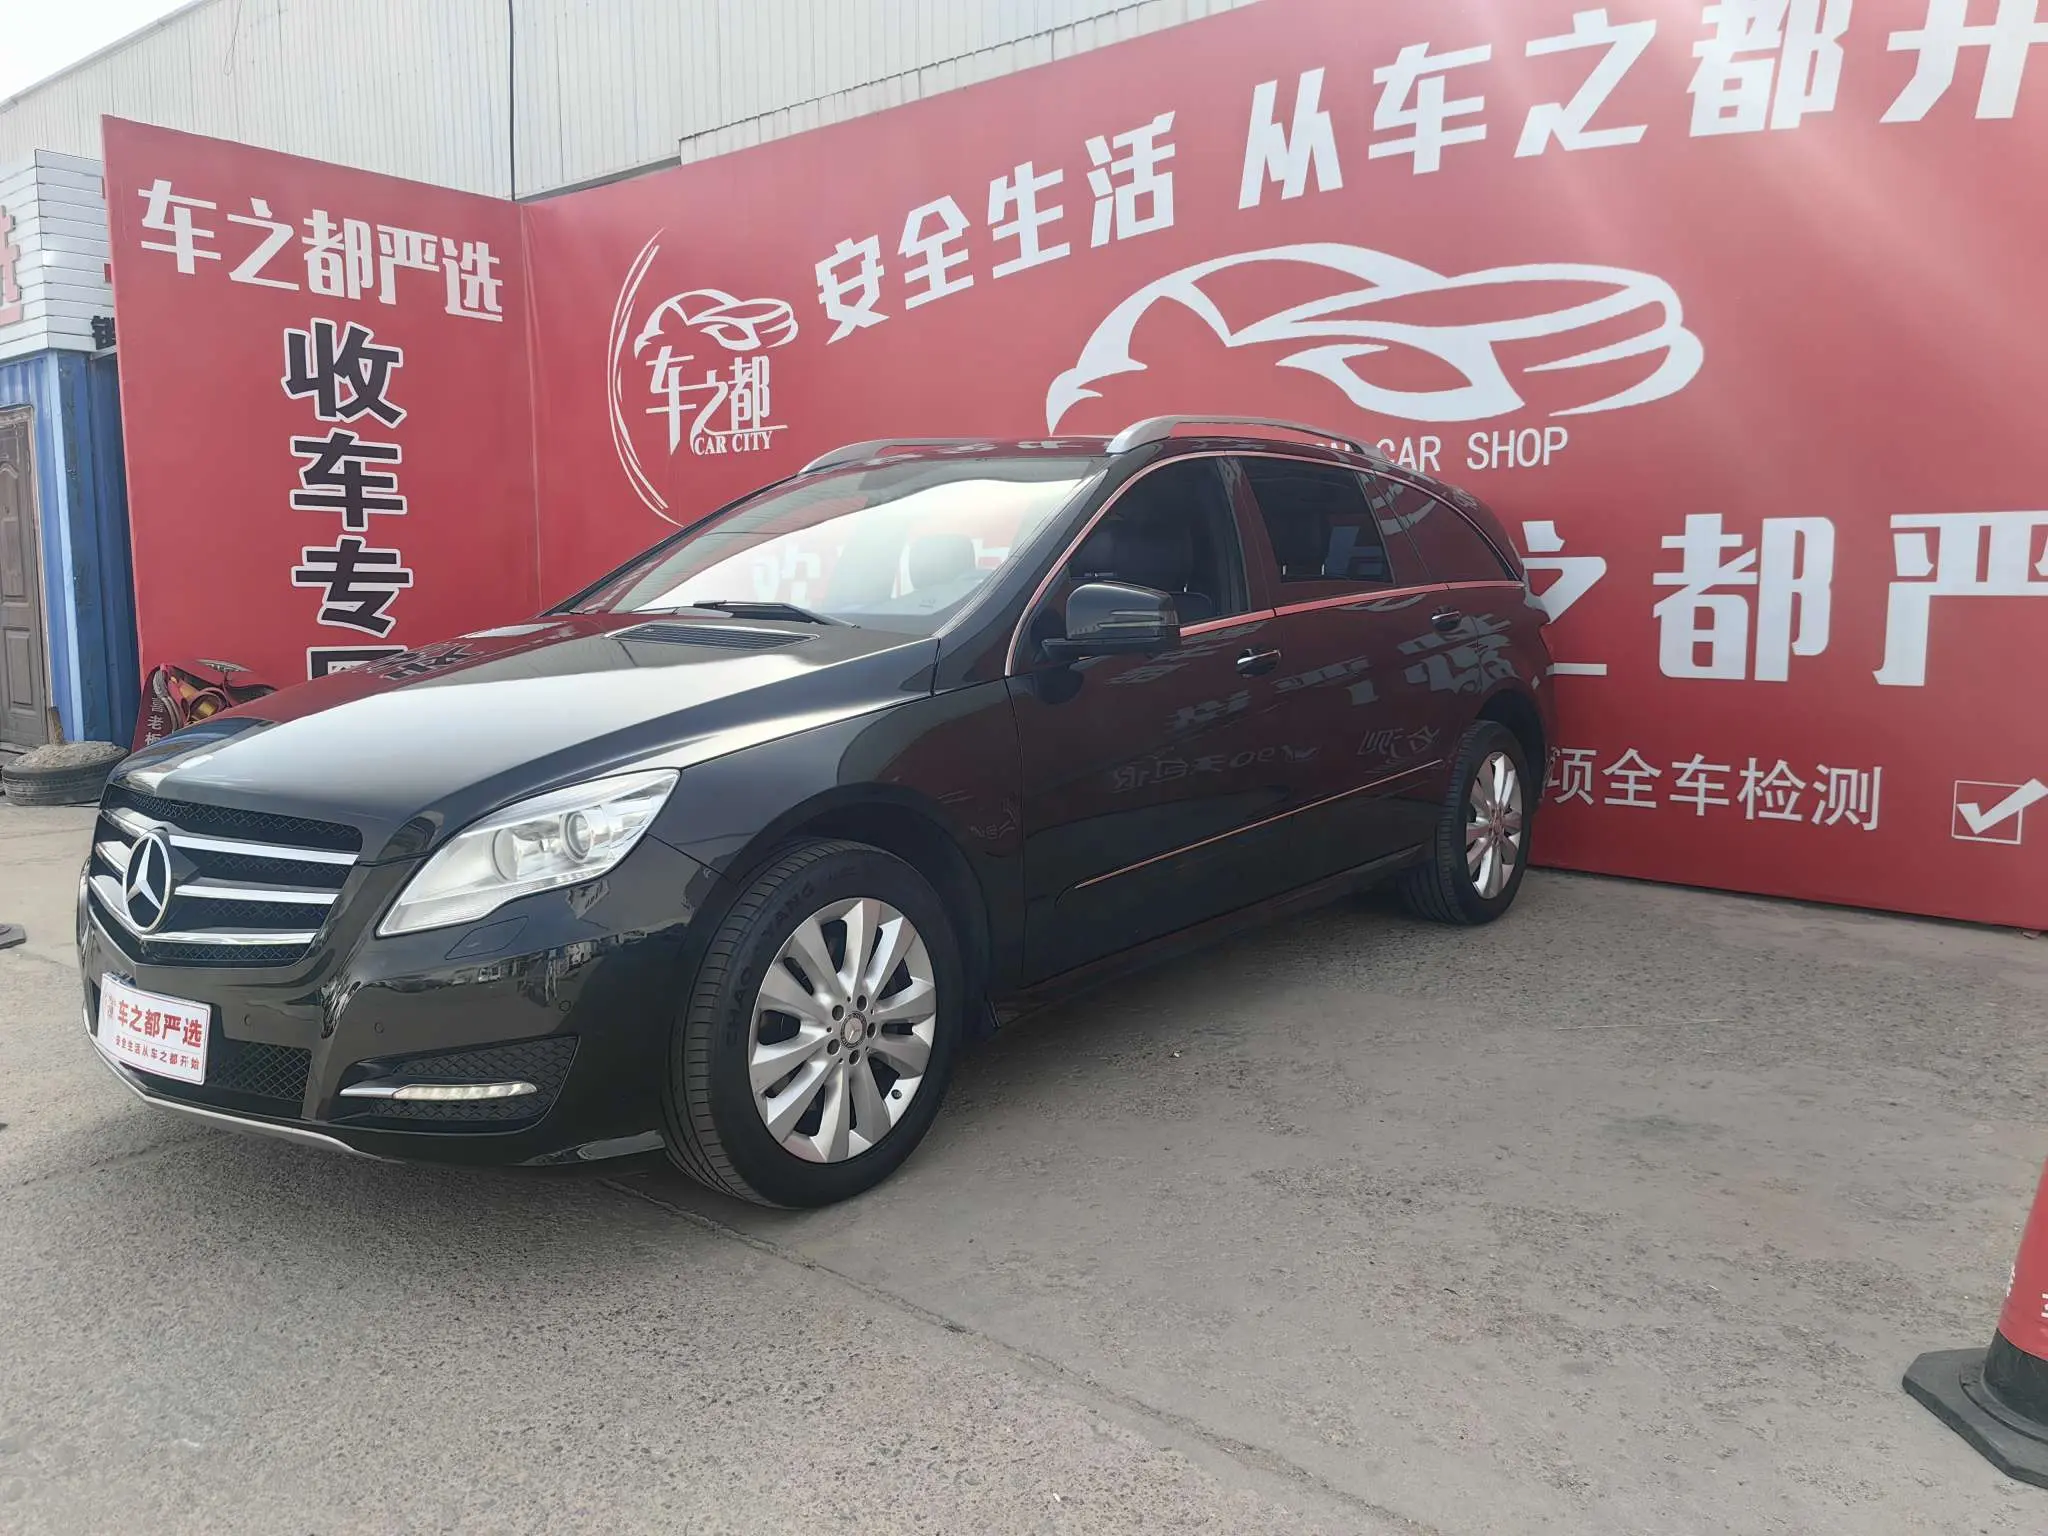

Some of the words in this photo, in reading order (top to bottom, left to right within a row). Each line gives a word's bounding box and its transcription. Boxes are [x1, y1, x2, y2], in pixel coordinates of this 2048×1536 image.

[138, 178, 503, 322] 车之都严选
[814, 109, 1176, 345] 安全生活
[645, 345, 788, 455] 车之都
[694, 435, 728, 456] CAR
[732, 430, 773, 453] CITY
[1466, 426, 1570, 471] SHOP
[281, 317, 413, 681] 收车专
[115, 1034, 200, 1071] 安全生活从车之都开始
[118, 999, 203, 1048] 车之都严选
